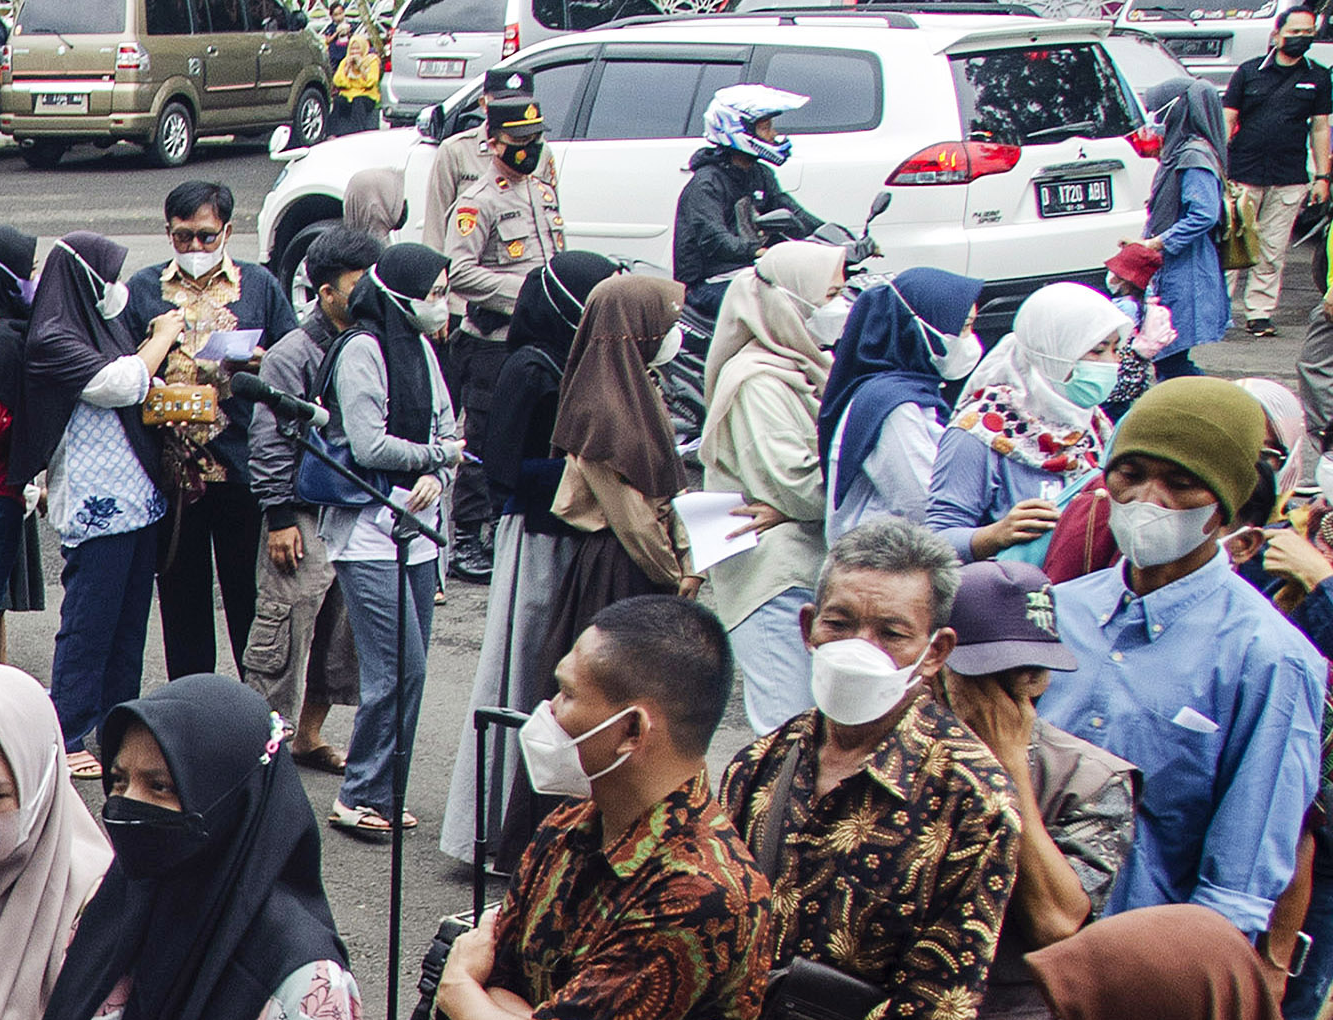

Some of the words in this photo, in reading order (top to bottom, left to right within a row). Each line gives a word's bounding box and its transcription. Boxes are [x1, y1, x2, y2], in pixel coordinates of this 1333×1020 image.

[1041, 187, 1049, 206] D
[1059, 184, 1083, 204] 1720
[977, 216, 1001, 225] SPORT
